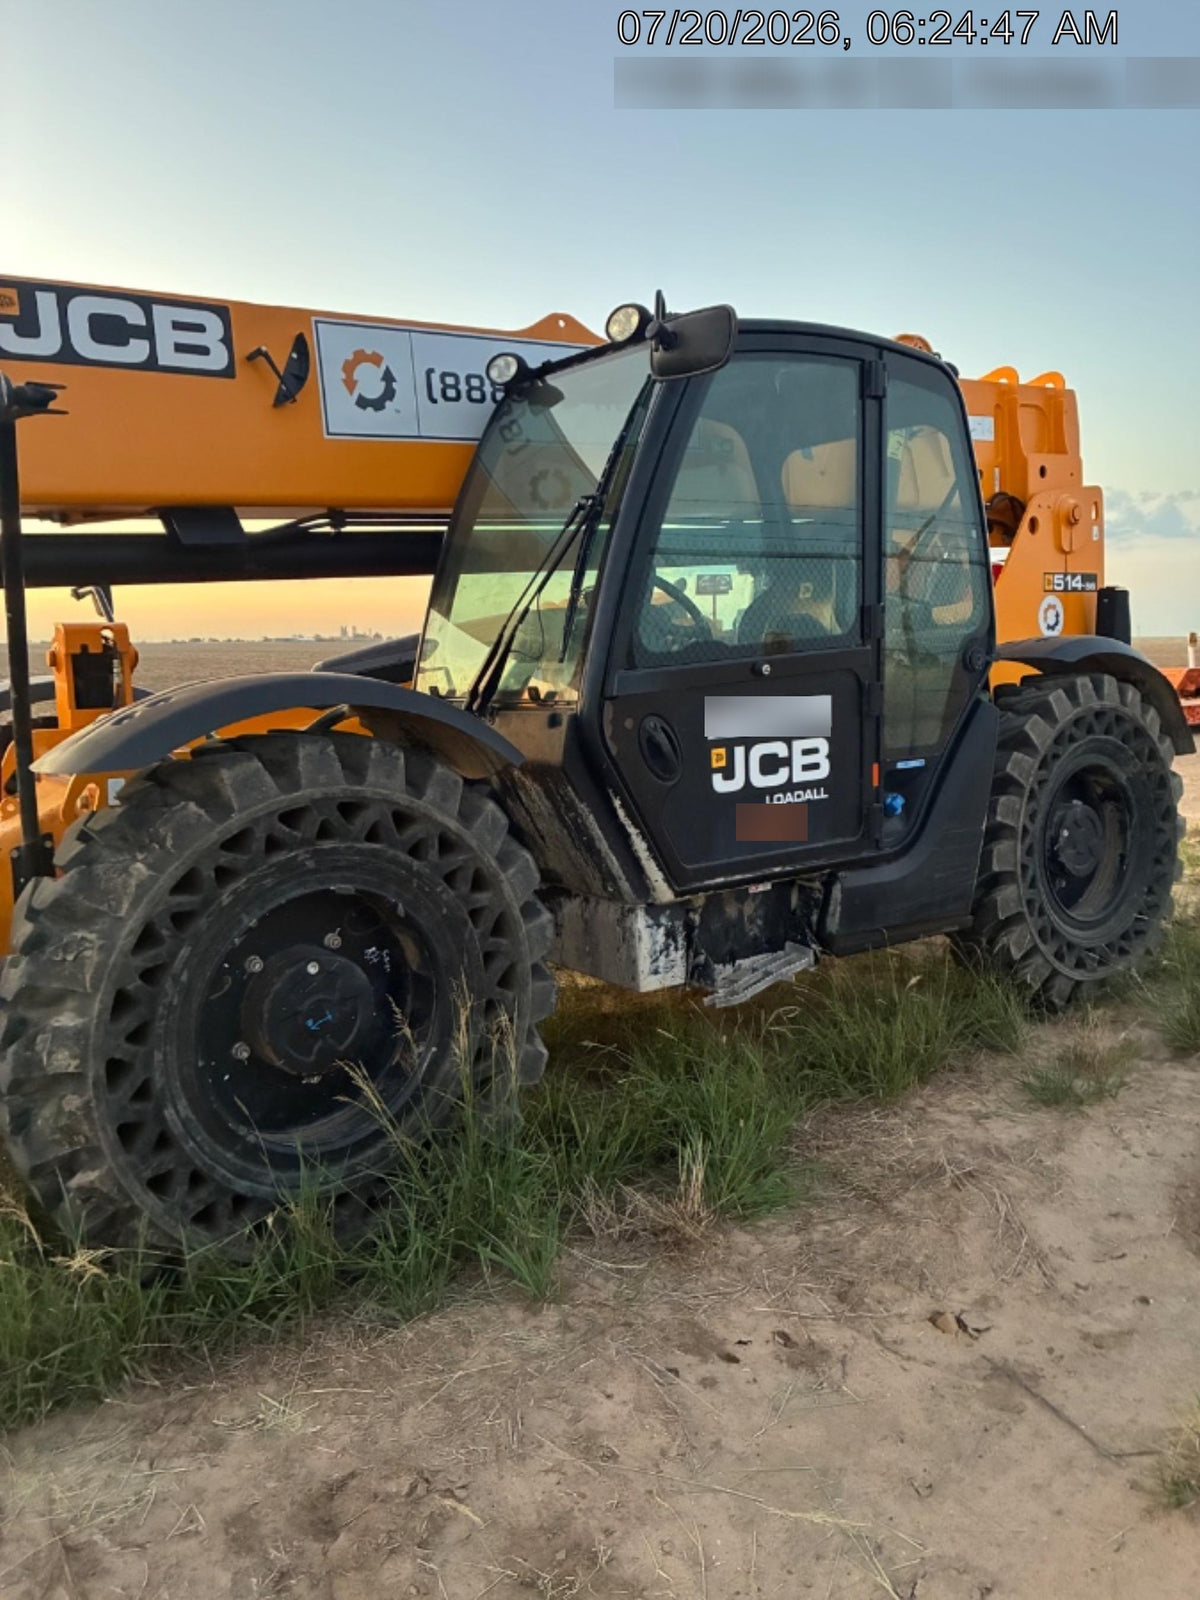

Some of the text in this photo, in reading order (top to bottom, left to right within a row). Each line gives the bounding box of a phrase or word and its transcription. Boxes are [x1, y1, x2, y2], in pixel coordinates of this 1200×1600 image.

[0, 290, 229, 371] JCB
[712, 737, 831, 794] JCB
[765, 787, 829, 804] LOADALL
